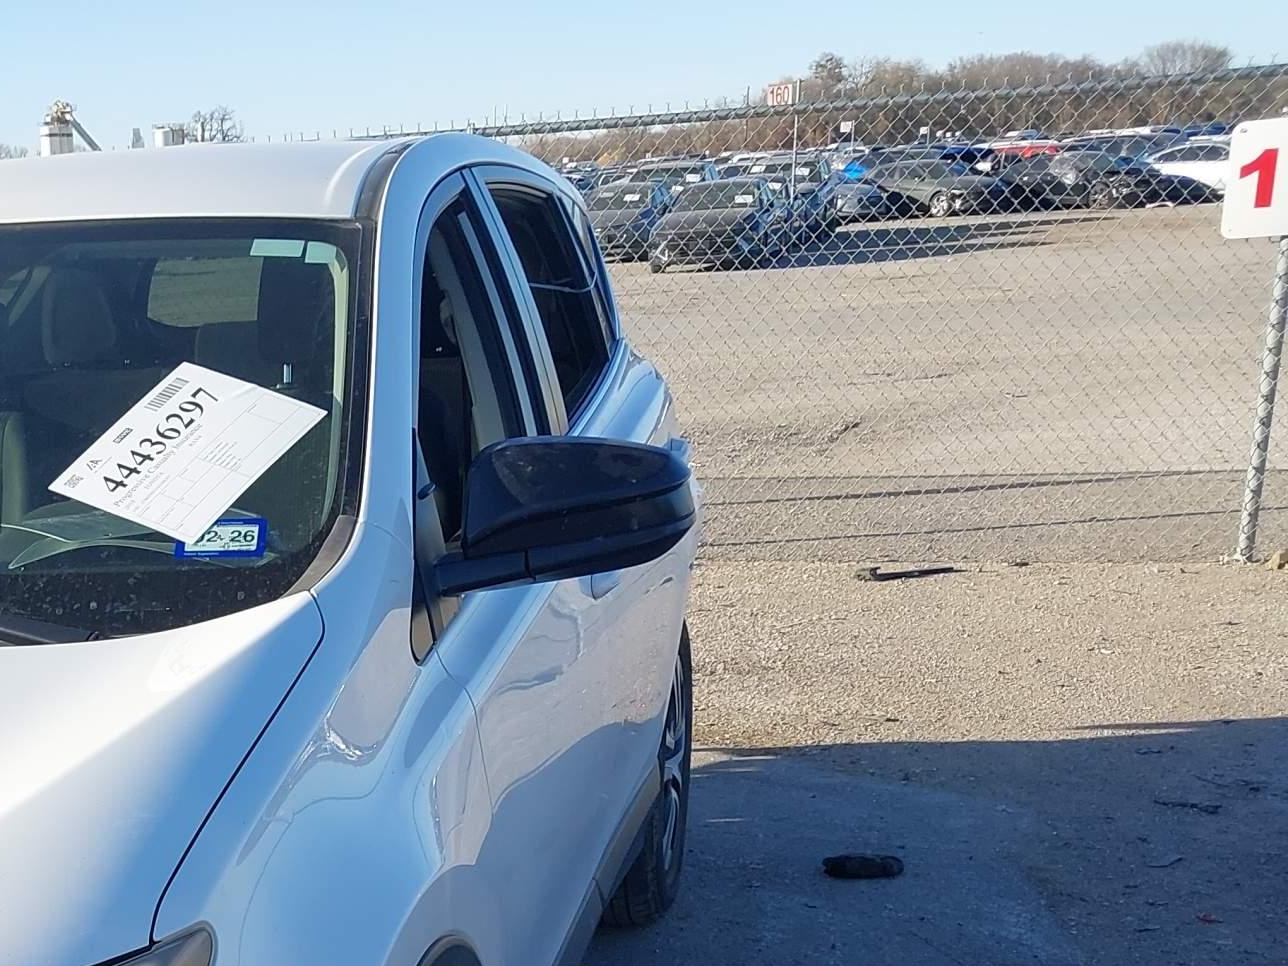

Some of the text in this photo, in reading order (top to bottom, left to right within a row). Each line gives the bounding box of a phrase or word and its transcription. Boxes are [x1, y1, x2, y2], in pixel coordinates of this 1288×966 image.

[769, 86, 790, 105] 160
[1240, 148, 1279, 208] 1
[103, 387, 219, 492] 44436297
[113, 471, 150, 507] Progressive
[229, 530, 255, 543] 26
